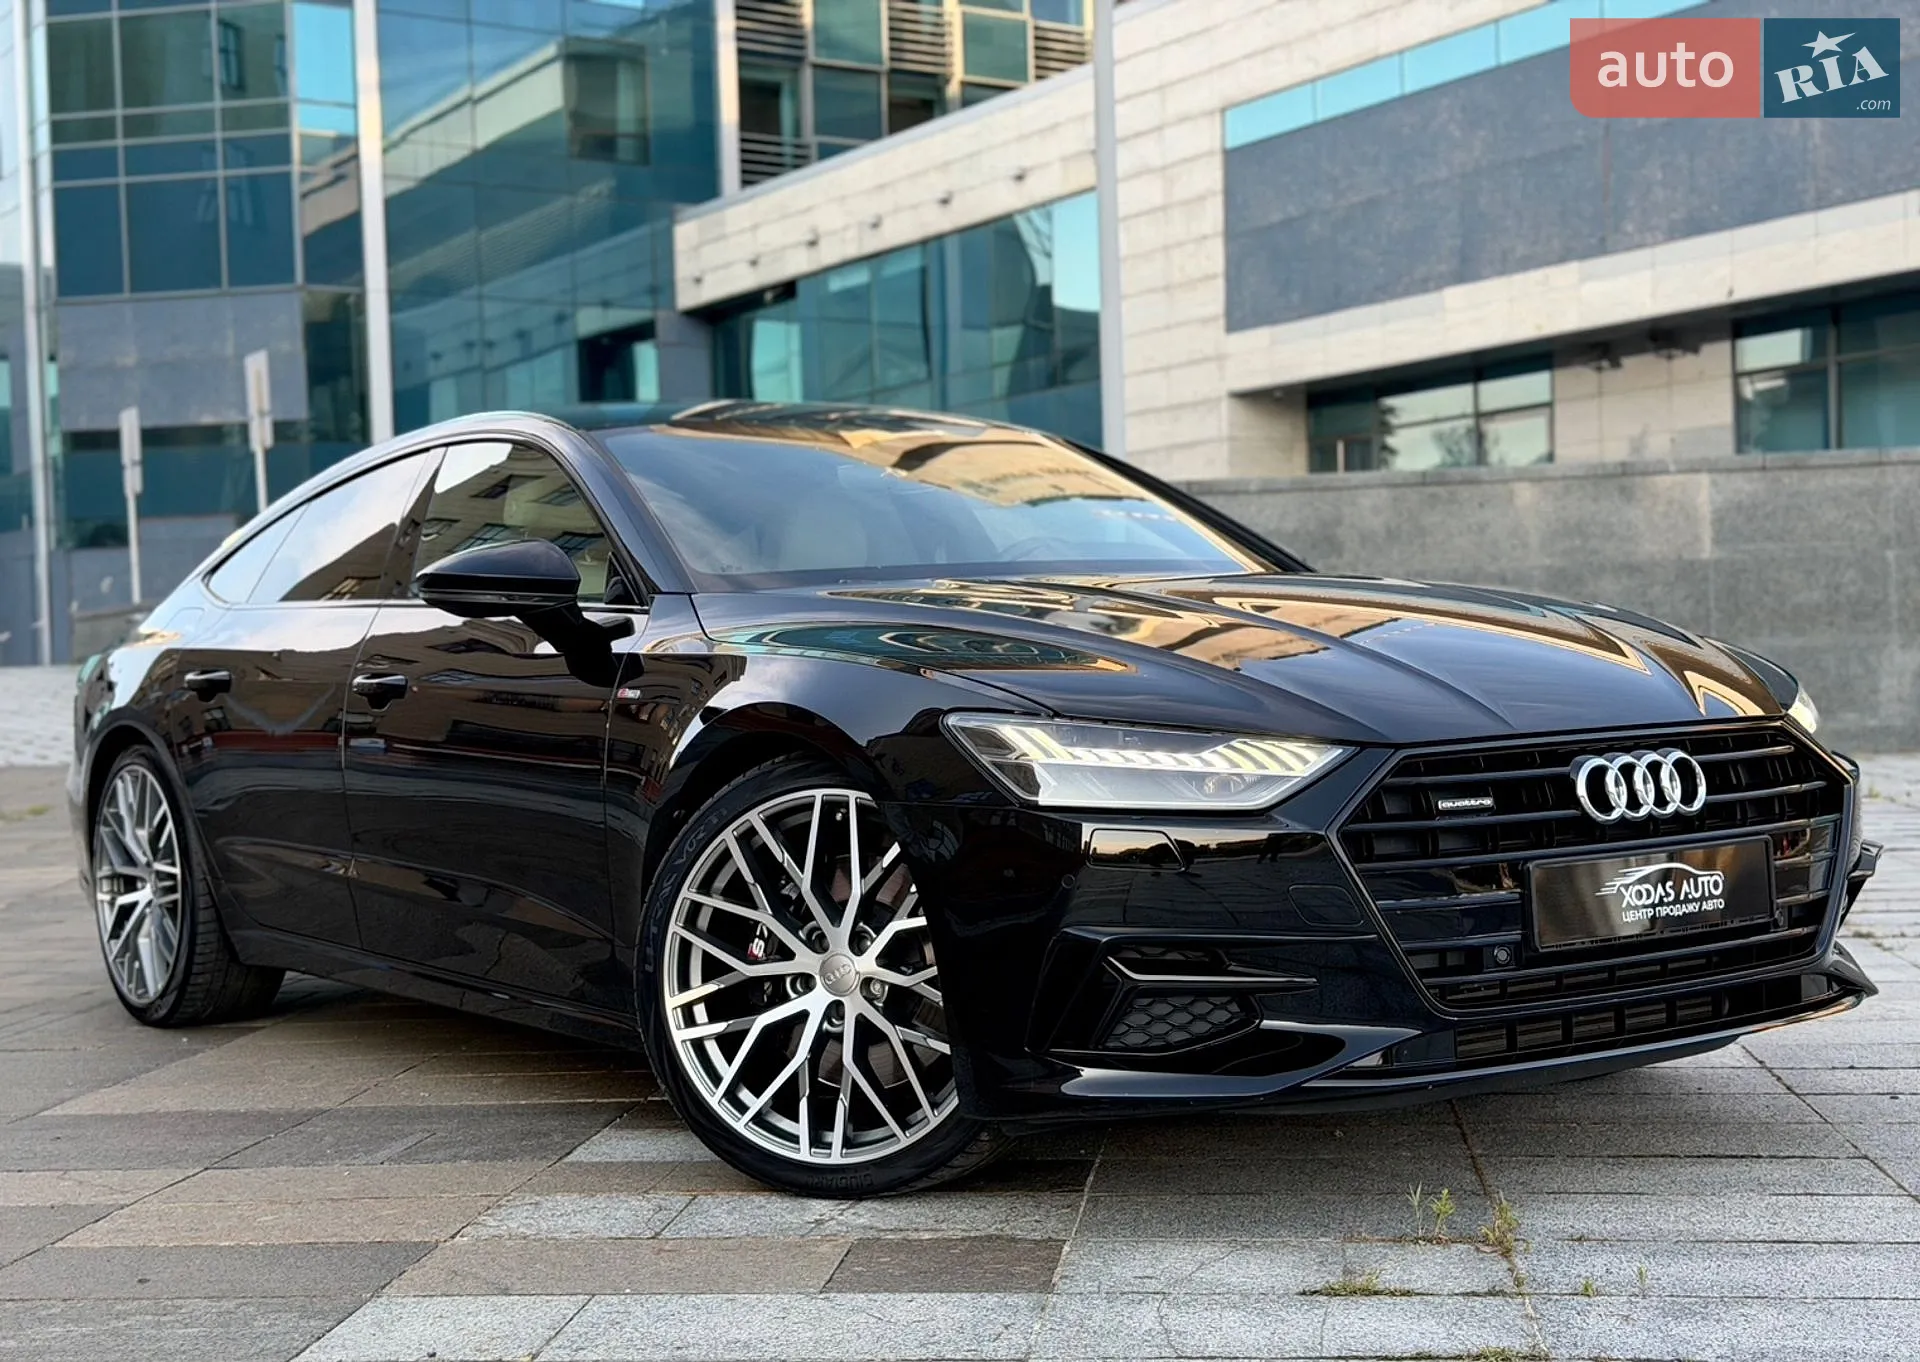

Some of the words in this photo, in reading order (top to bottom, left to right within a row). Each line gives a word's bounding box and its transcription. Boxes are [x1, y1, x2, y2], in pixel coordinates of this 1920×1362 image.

[1439, 798, 1493, 809] quattro
[1620, 881, 1675, 908] XODAS
[1680, 874, 1724, 900] AUTO
[1622, 908, 1655, 923] ЦЕНТР
[1655, 902, 1701, 918] ПРОДАЖУ
[1701, 899, 1725, 911] АВТО
